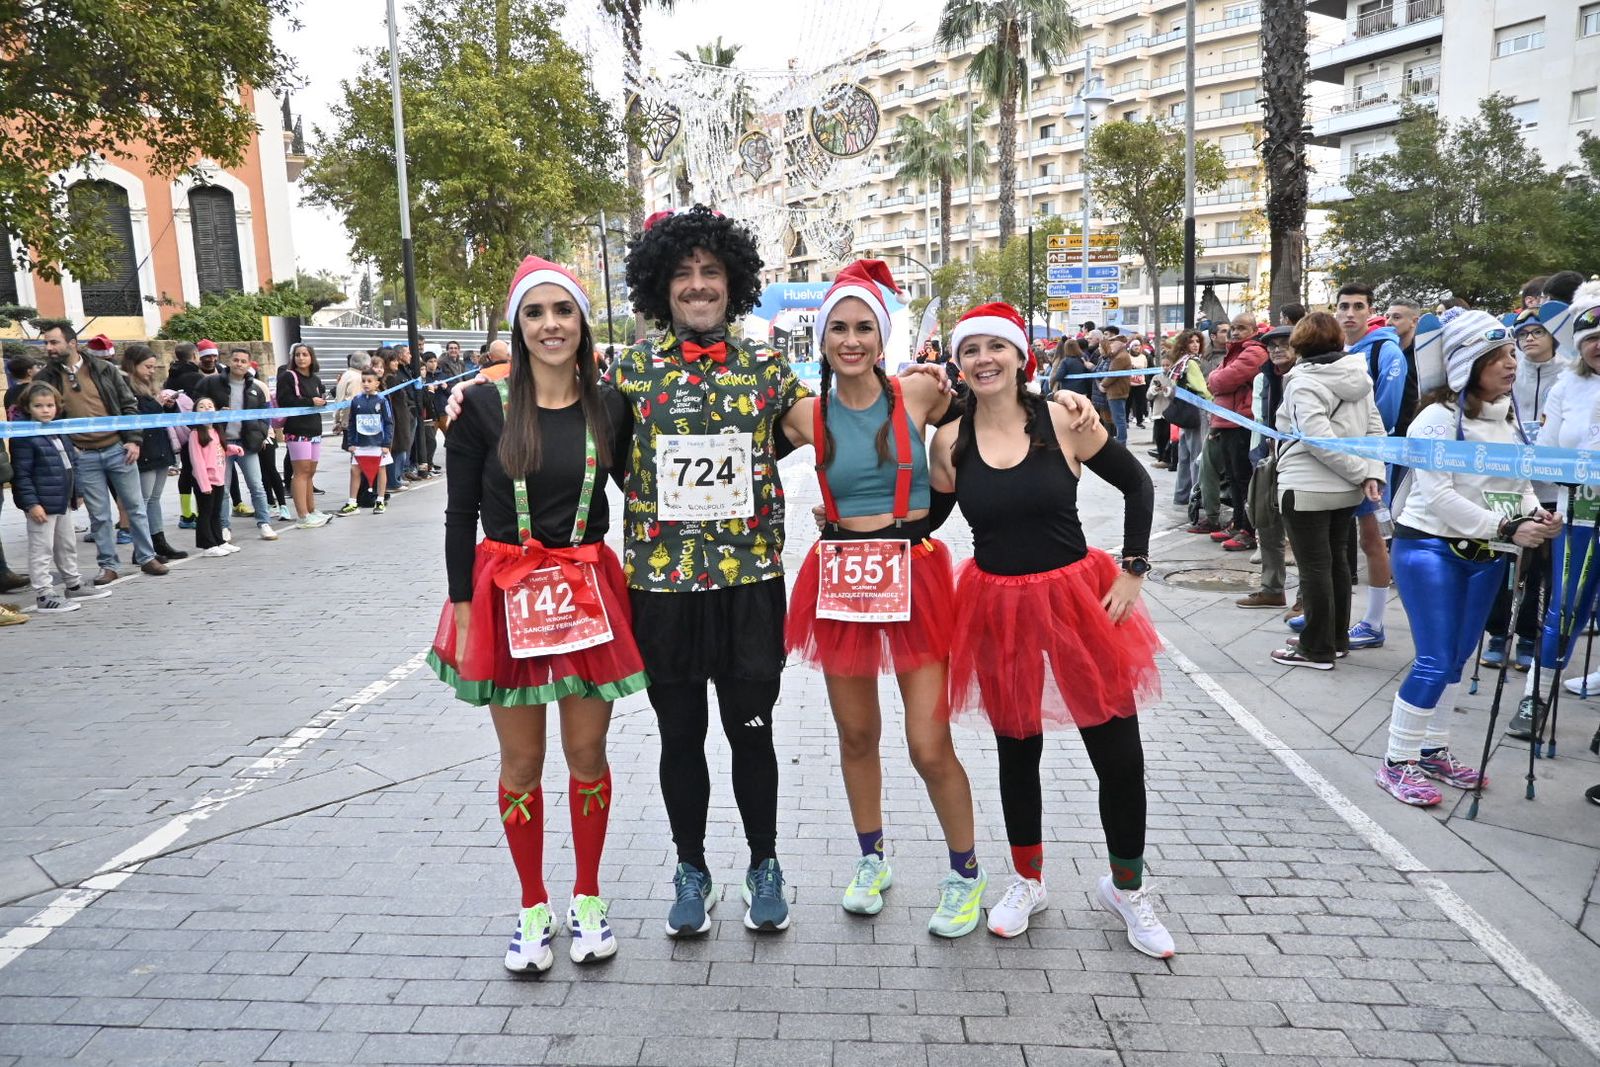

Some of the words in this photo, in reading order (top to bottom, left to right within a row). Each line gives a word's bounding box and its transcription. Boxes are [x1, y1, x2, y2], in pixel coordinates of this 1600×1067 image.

[783, 288, 823, 300] Huelva
[715, 374, 757, 387] GRINCH
[673, 455, 735, 487] 724
[1485, 462, 1511, 472] HUELVA
[1533, 466, 1563, 476] HUELVA
[826, 554, 900, 585] 1551
[513, 582, 575, 618] 142
[523, 624, 555, 634] SANCHEZ
